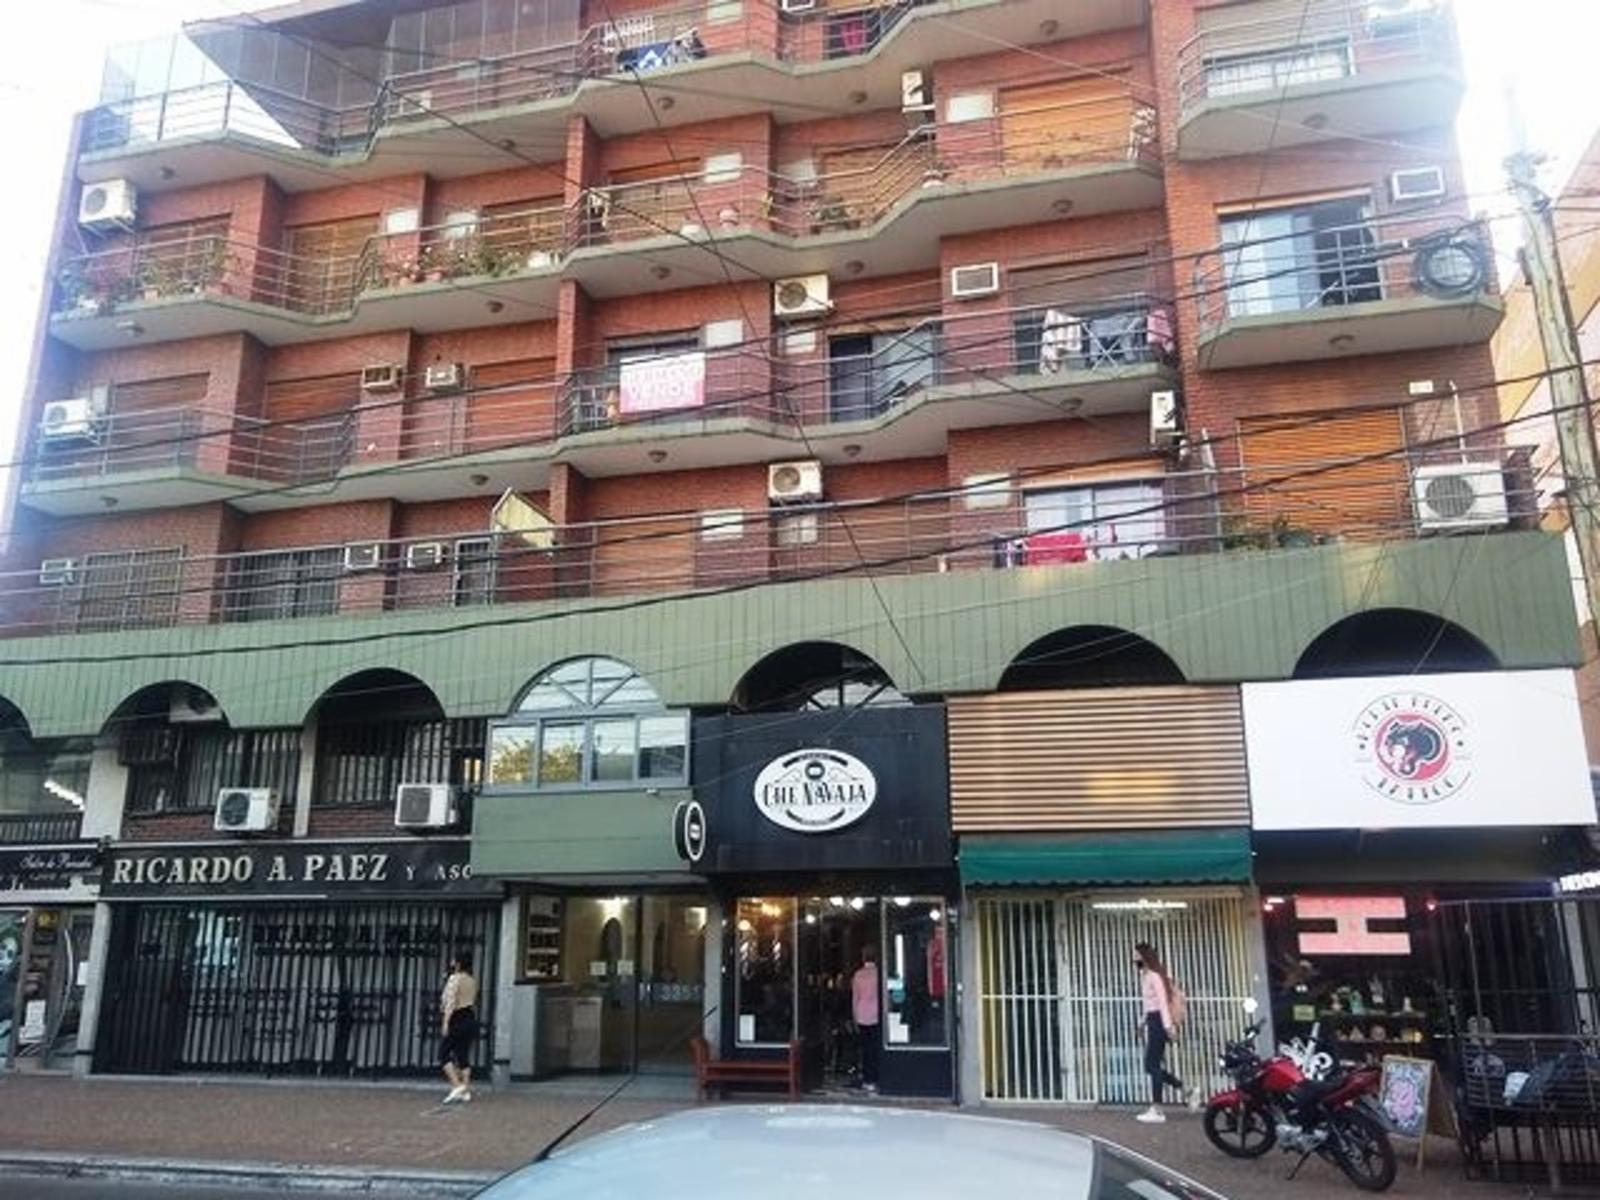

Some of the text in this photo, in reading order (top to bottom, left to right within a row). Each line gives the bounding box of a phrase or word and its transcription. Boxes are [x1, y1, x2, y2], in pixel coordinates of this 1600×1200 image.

[111, 856, 253, 885] RICARDO
[267, 856, 294, 882] A.
[303, 854, 389, 881] PAEZ
